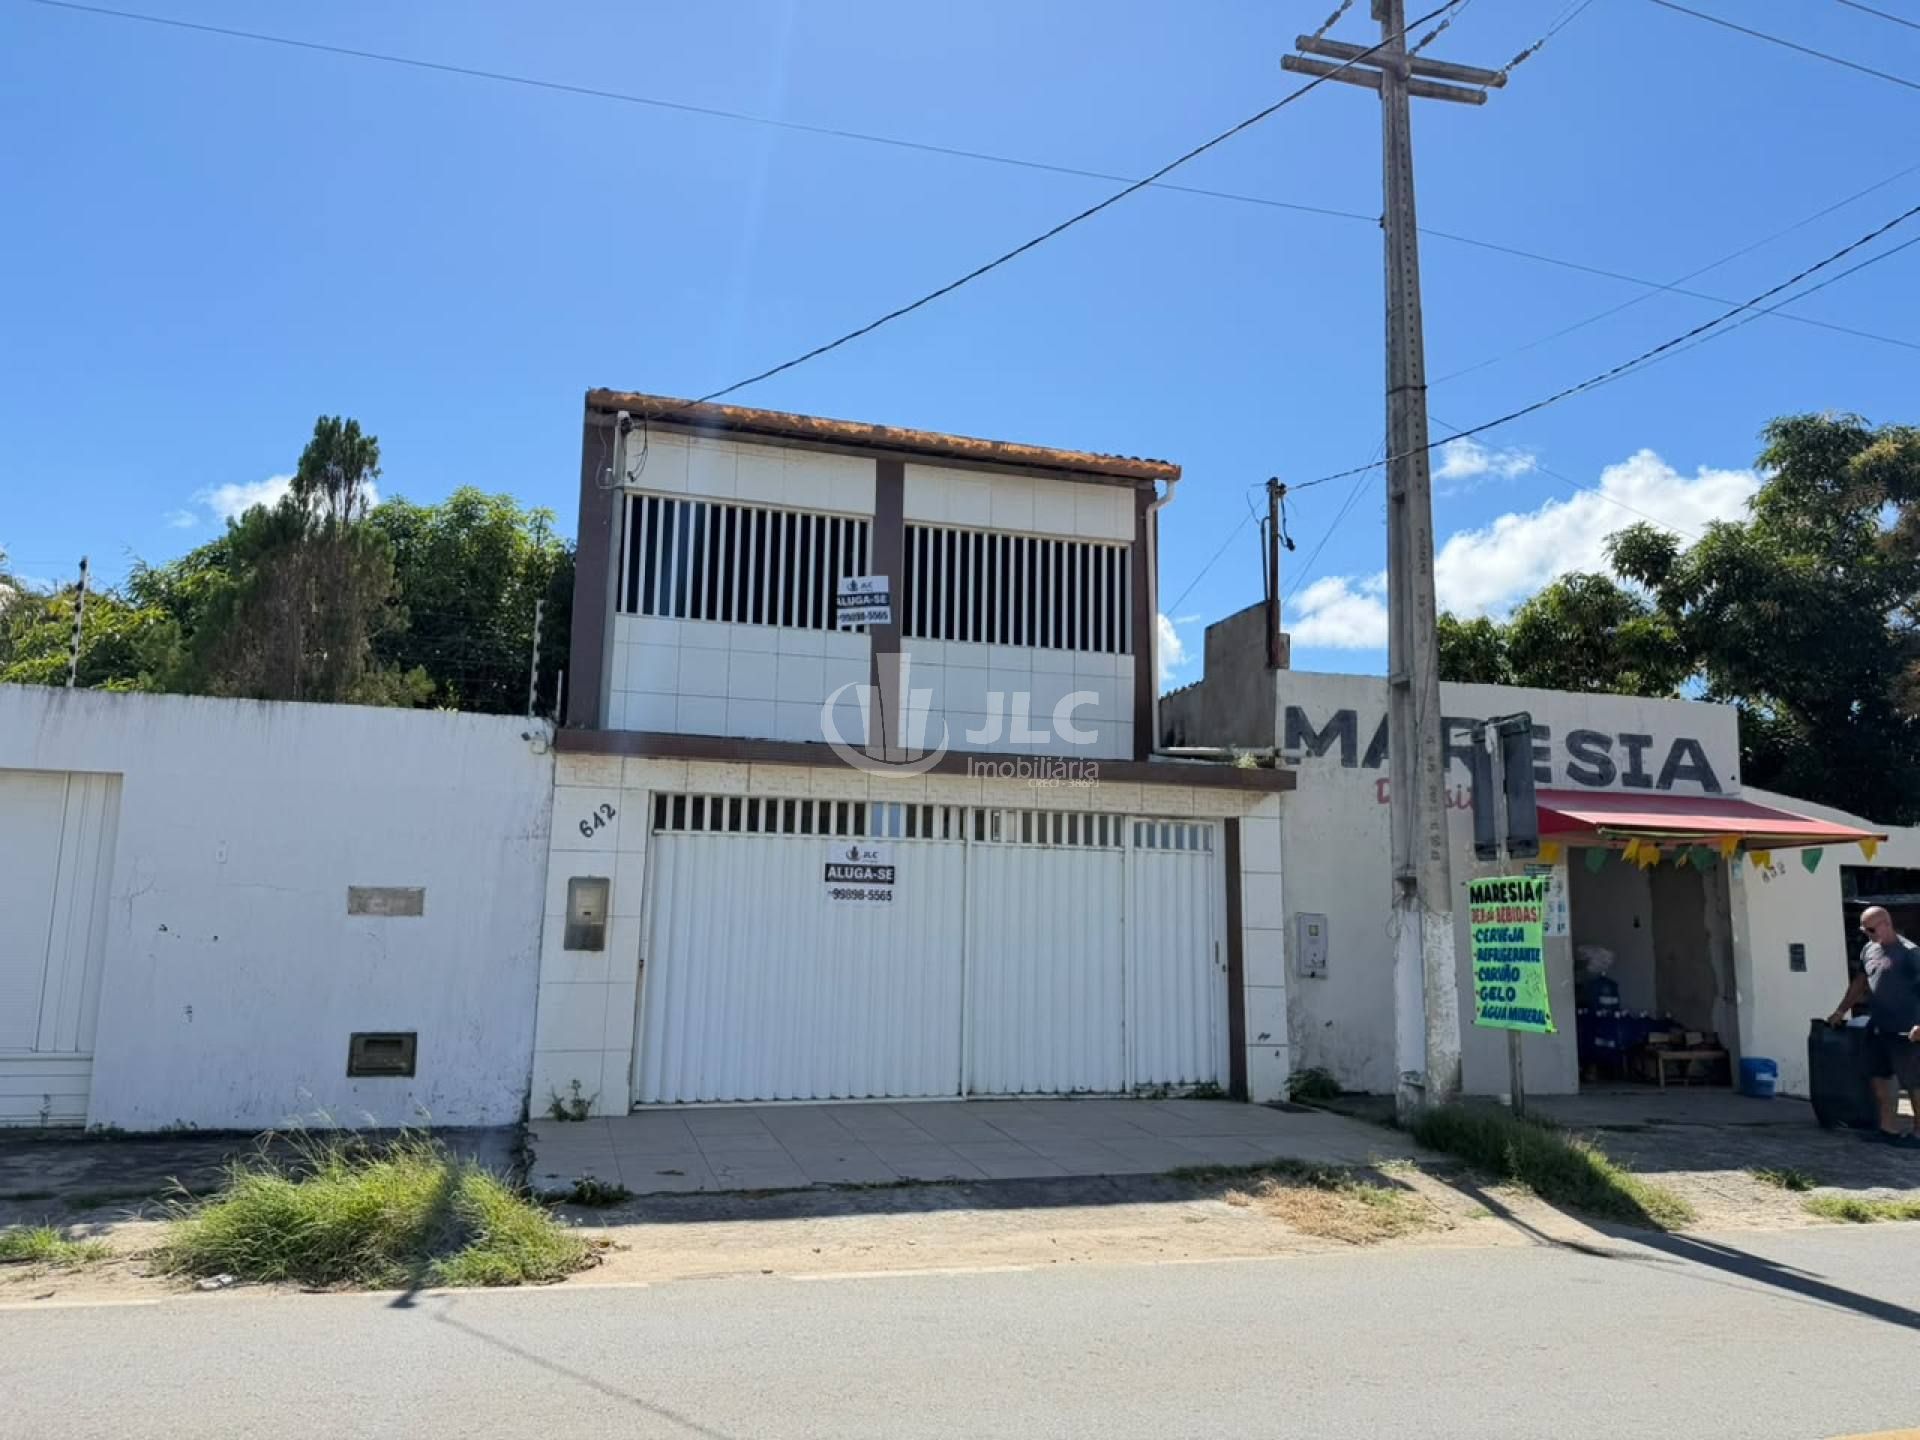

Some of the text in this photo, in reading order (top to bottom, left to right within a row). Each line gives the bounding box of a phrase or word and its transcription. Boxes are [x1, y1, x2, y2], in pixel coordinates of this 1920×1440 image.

[579, 803, 616, 838] 642
[828, 866, 894, 881] ALUGA-SE
[1470, 881, 1535, 904] MARESIA
[1475, 927, 1525, 943] CERVEJA
[1480, 986, 1516, 1002] GELO
